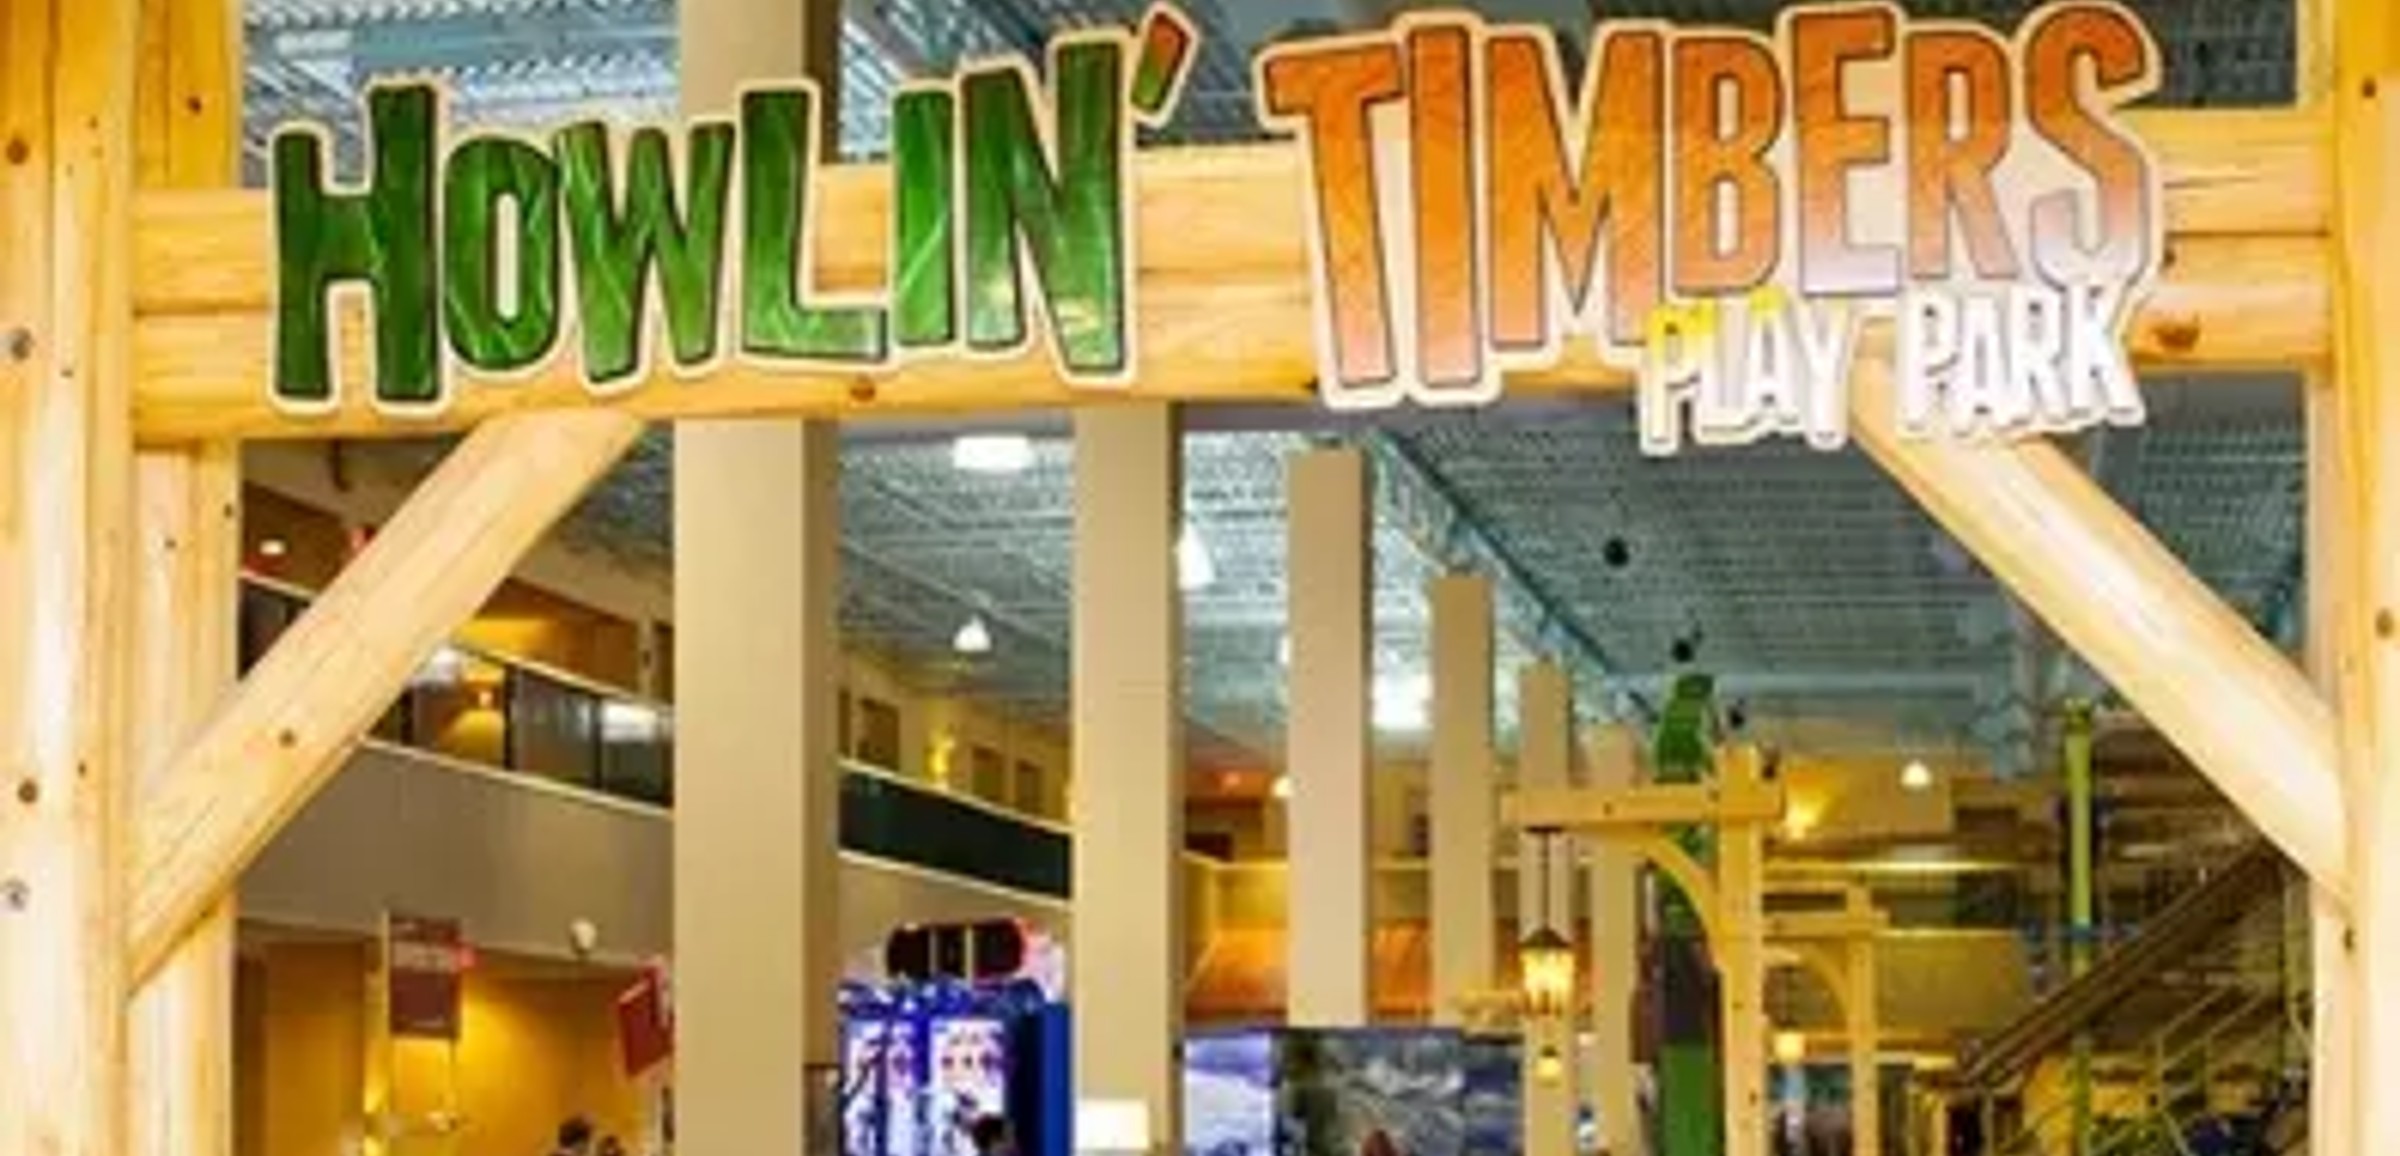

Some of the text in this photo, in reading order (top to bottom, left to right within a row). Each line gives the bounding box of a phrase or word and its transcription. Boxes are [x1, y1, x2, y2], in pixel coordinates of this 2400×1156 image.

[272, 6, 2150, 404] HOWLIN' TIMBERS
[1645, 284, 2140, 445] PLAY PARK
